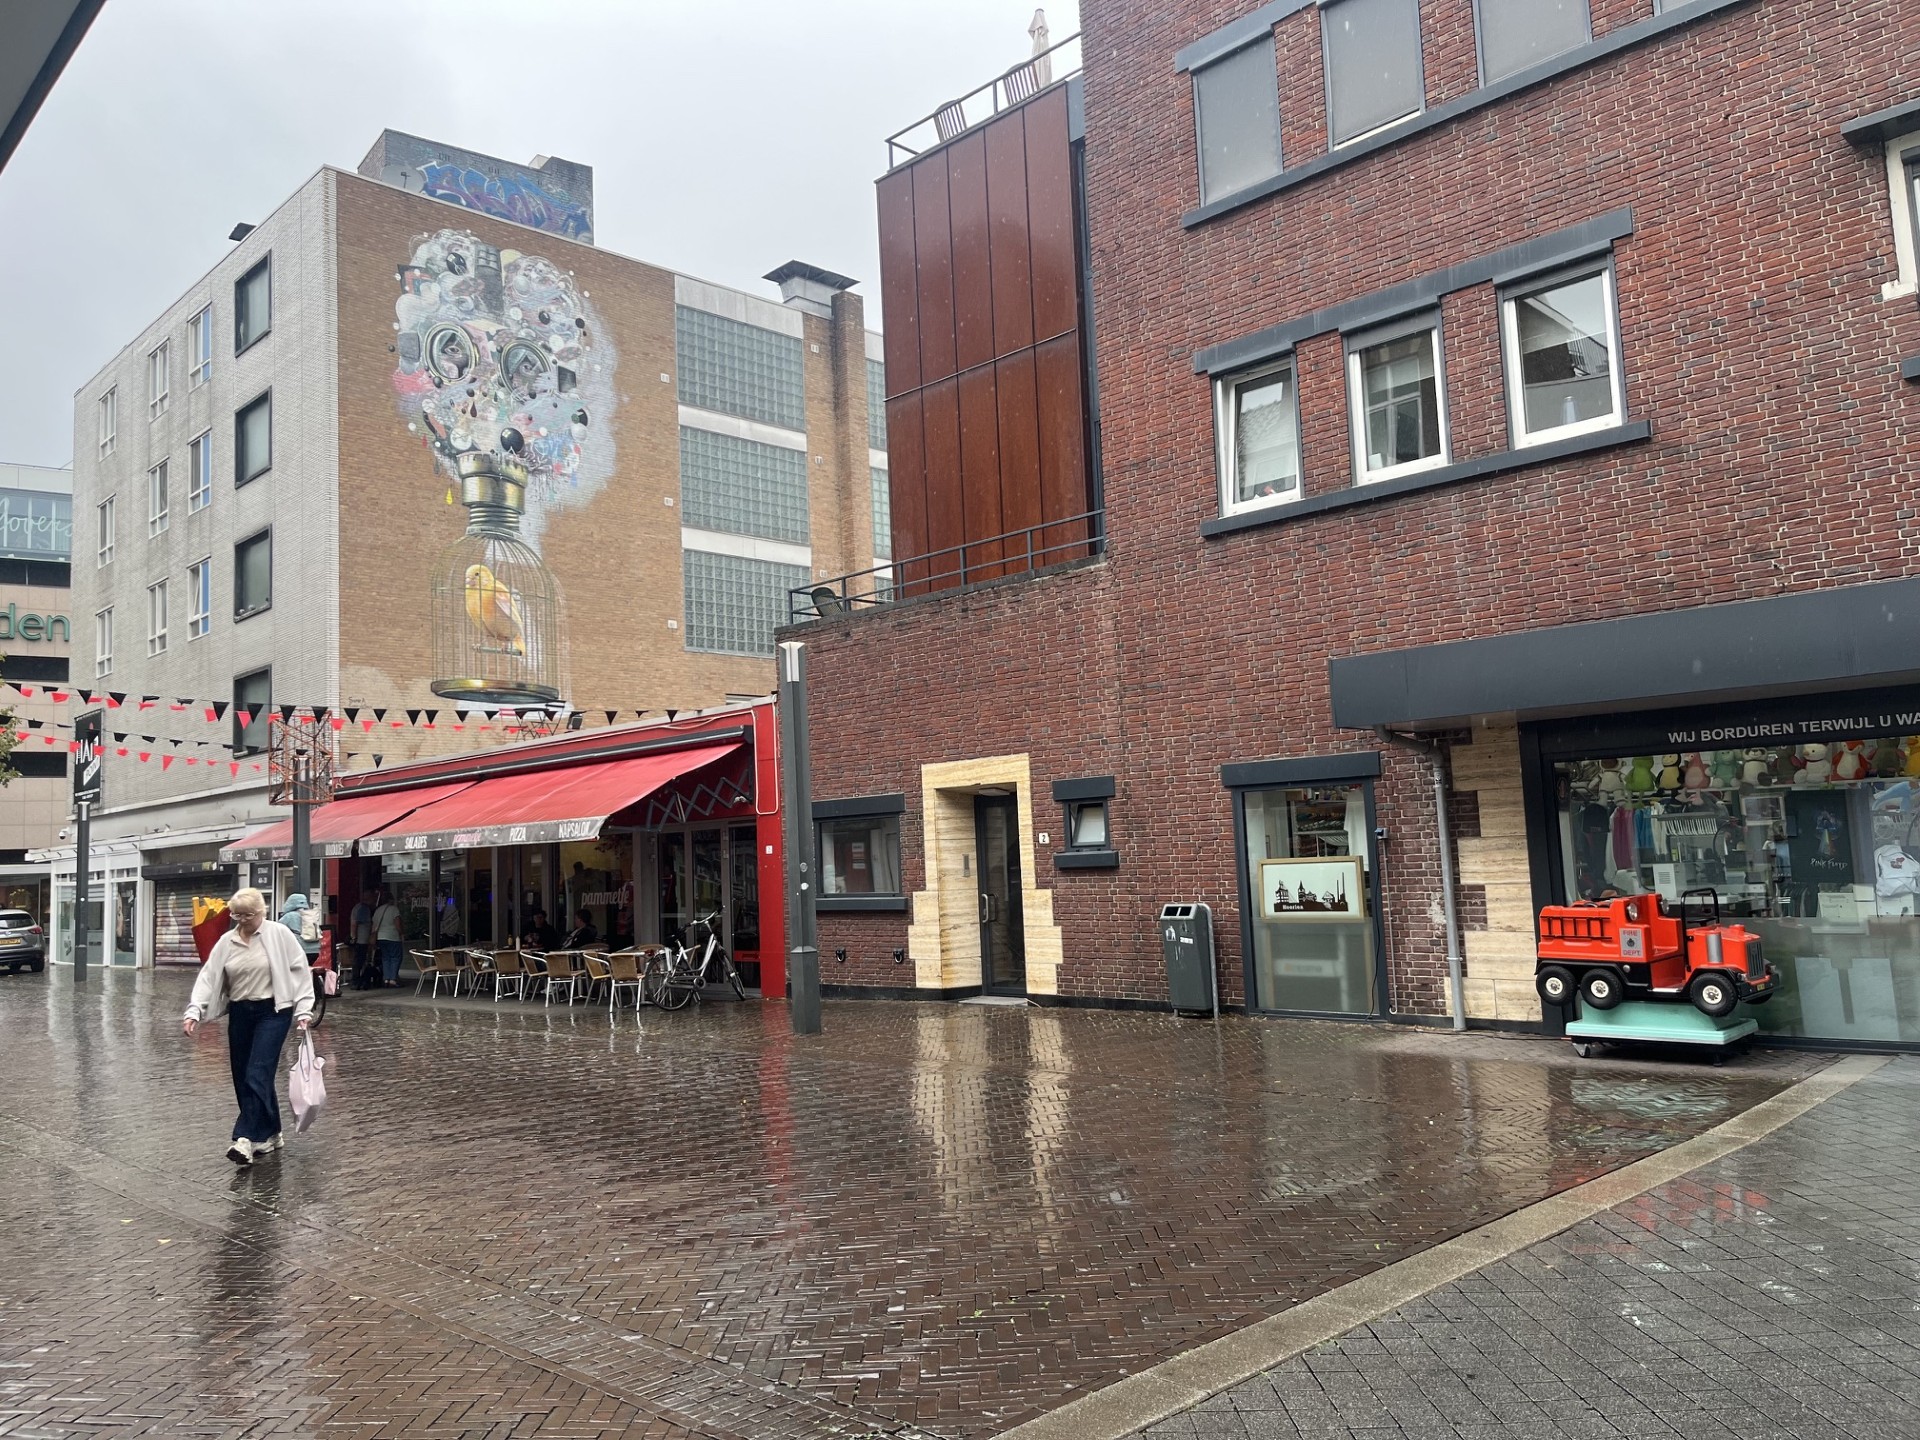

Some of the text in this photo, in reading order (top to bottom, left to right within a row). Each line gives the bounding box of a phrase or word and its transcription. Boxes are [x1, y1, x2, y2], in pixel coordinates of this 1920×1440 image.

[1668, 731, 1696, 743] WIJ
[1701, 722, 1794, 741] BORDUREN
[1799, 717, 1875, 733] TERWIJL
[1880, 715, 1891, 727] U
[509, 826, 527, 842] PIZZA
[1041, 834, 1046, 843] 2
[580, 883, 630, 911] pammetje
